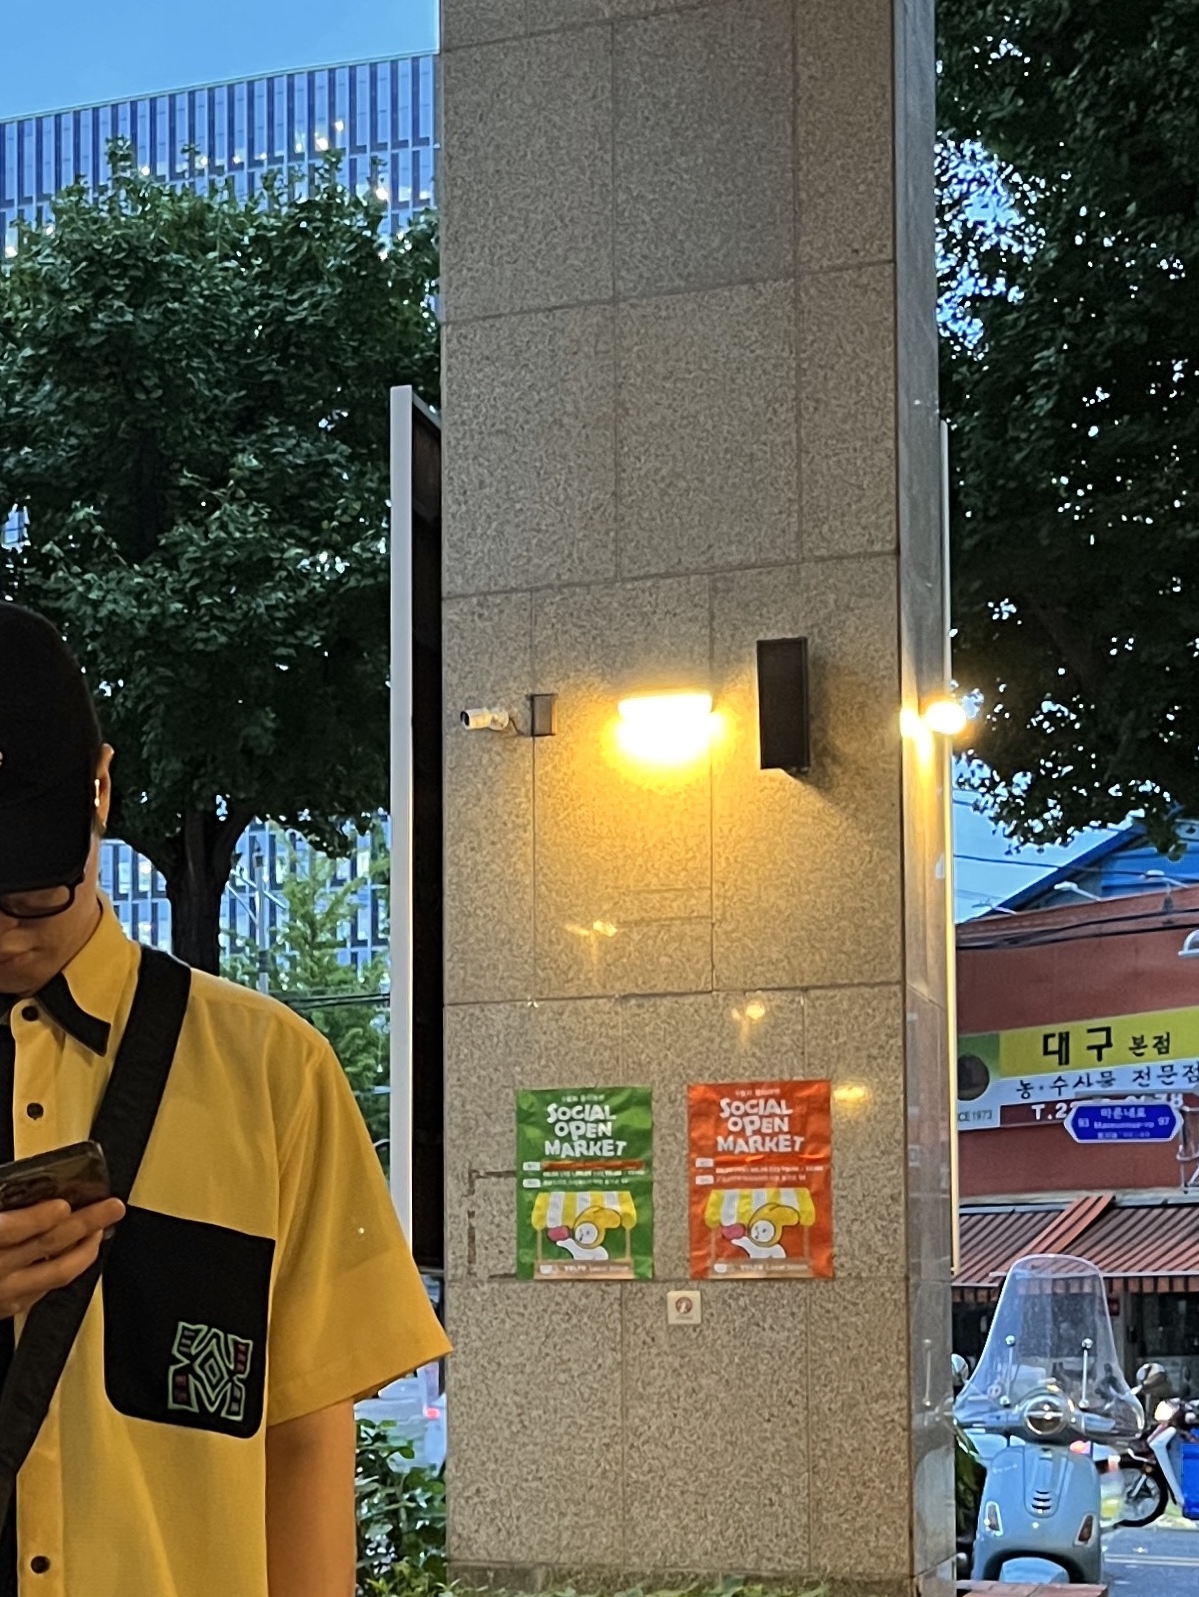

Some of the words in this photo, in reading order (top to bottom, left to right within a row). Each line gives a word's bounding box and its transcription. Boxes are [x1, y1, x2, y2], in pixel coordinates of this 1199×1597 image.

[1128, 1031, 1171, 1057] 본점
[1132, 1061, 1199, 1087] 전문점
[546, 1103, 617, 1124] SOCIAL
[719, 1098, 793, 1118] SOCIAL
[554, 1120, 613, 1140] OPEN
[727, 1115, 789, 1136] OPEN
[544, 1139, 627, 1159] MARKET
[716, 1134, 805, 1155] MARKET
